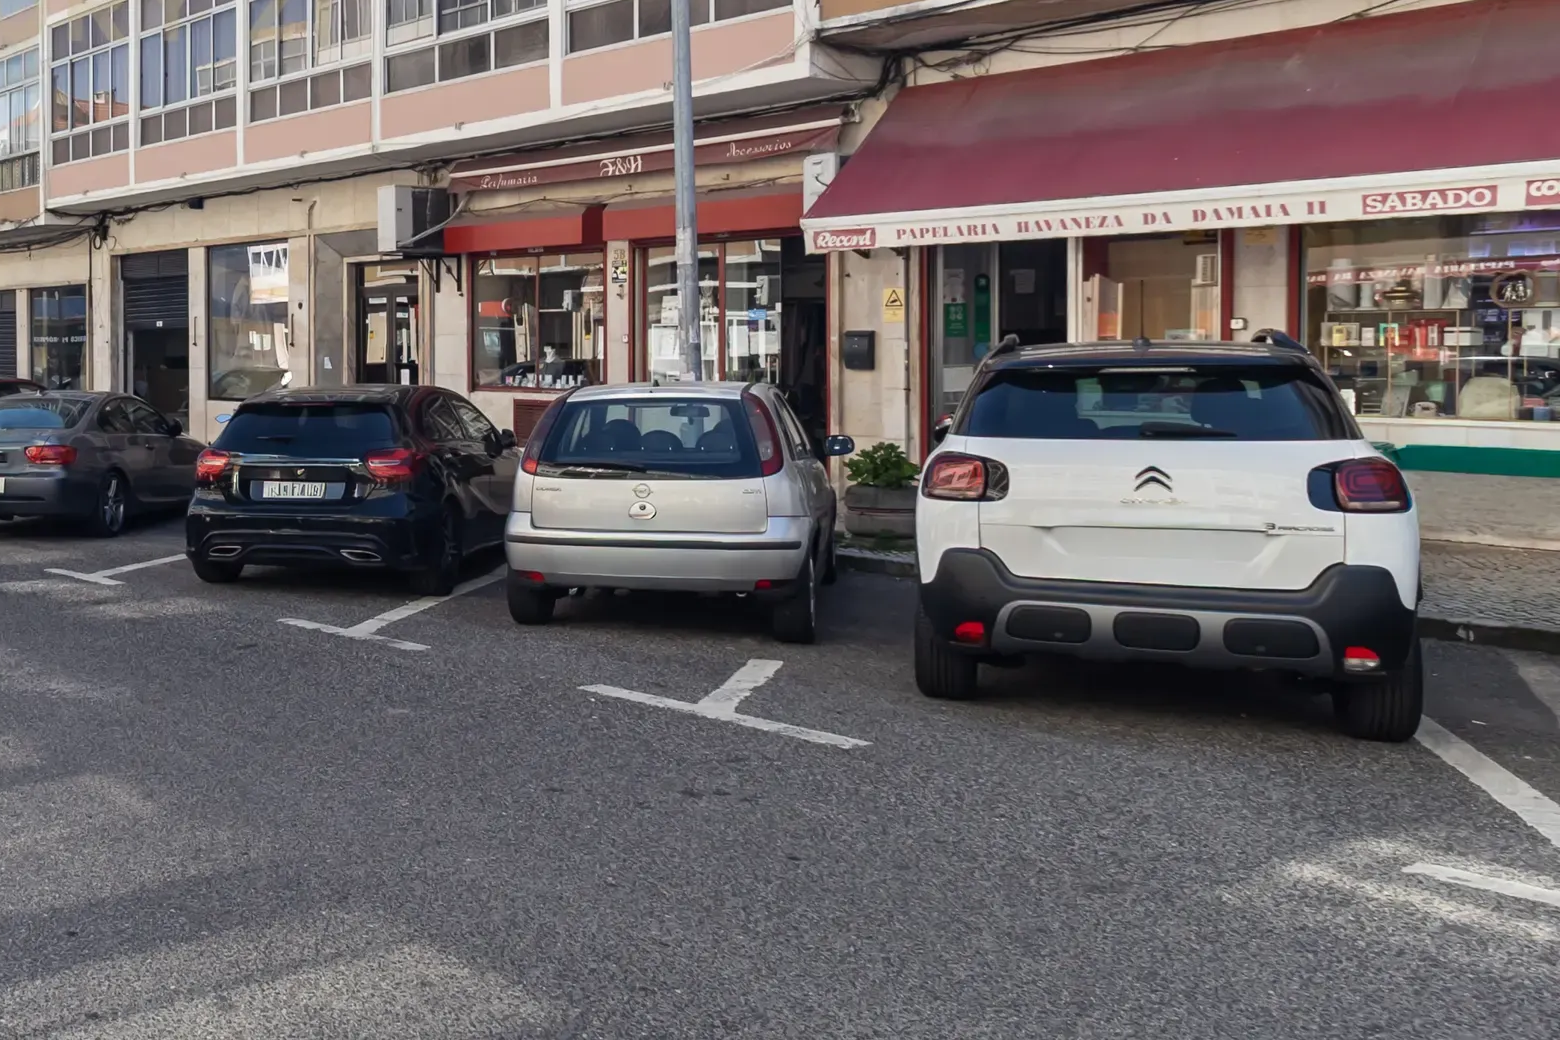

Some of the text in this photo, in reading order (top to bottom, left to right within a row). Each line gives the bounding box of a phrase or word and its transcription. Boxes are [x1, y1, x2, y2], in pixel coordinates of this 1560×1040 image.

[1528, 179, 1560, 197] CO
[1365, 187, 1493, 212] SÁBADO
[896, 200, 1327, 241] PAPELARIA HAVANEZA DA DAMAIA II
[816, 229, 872, 248] Record
